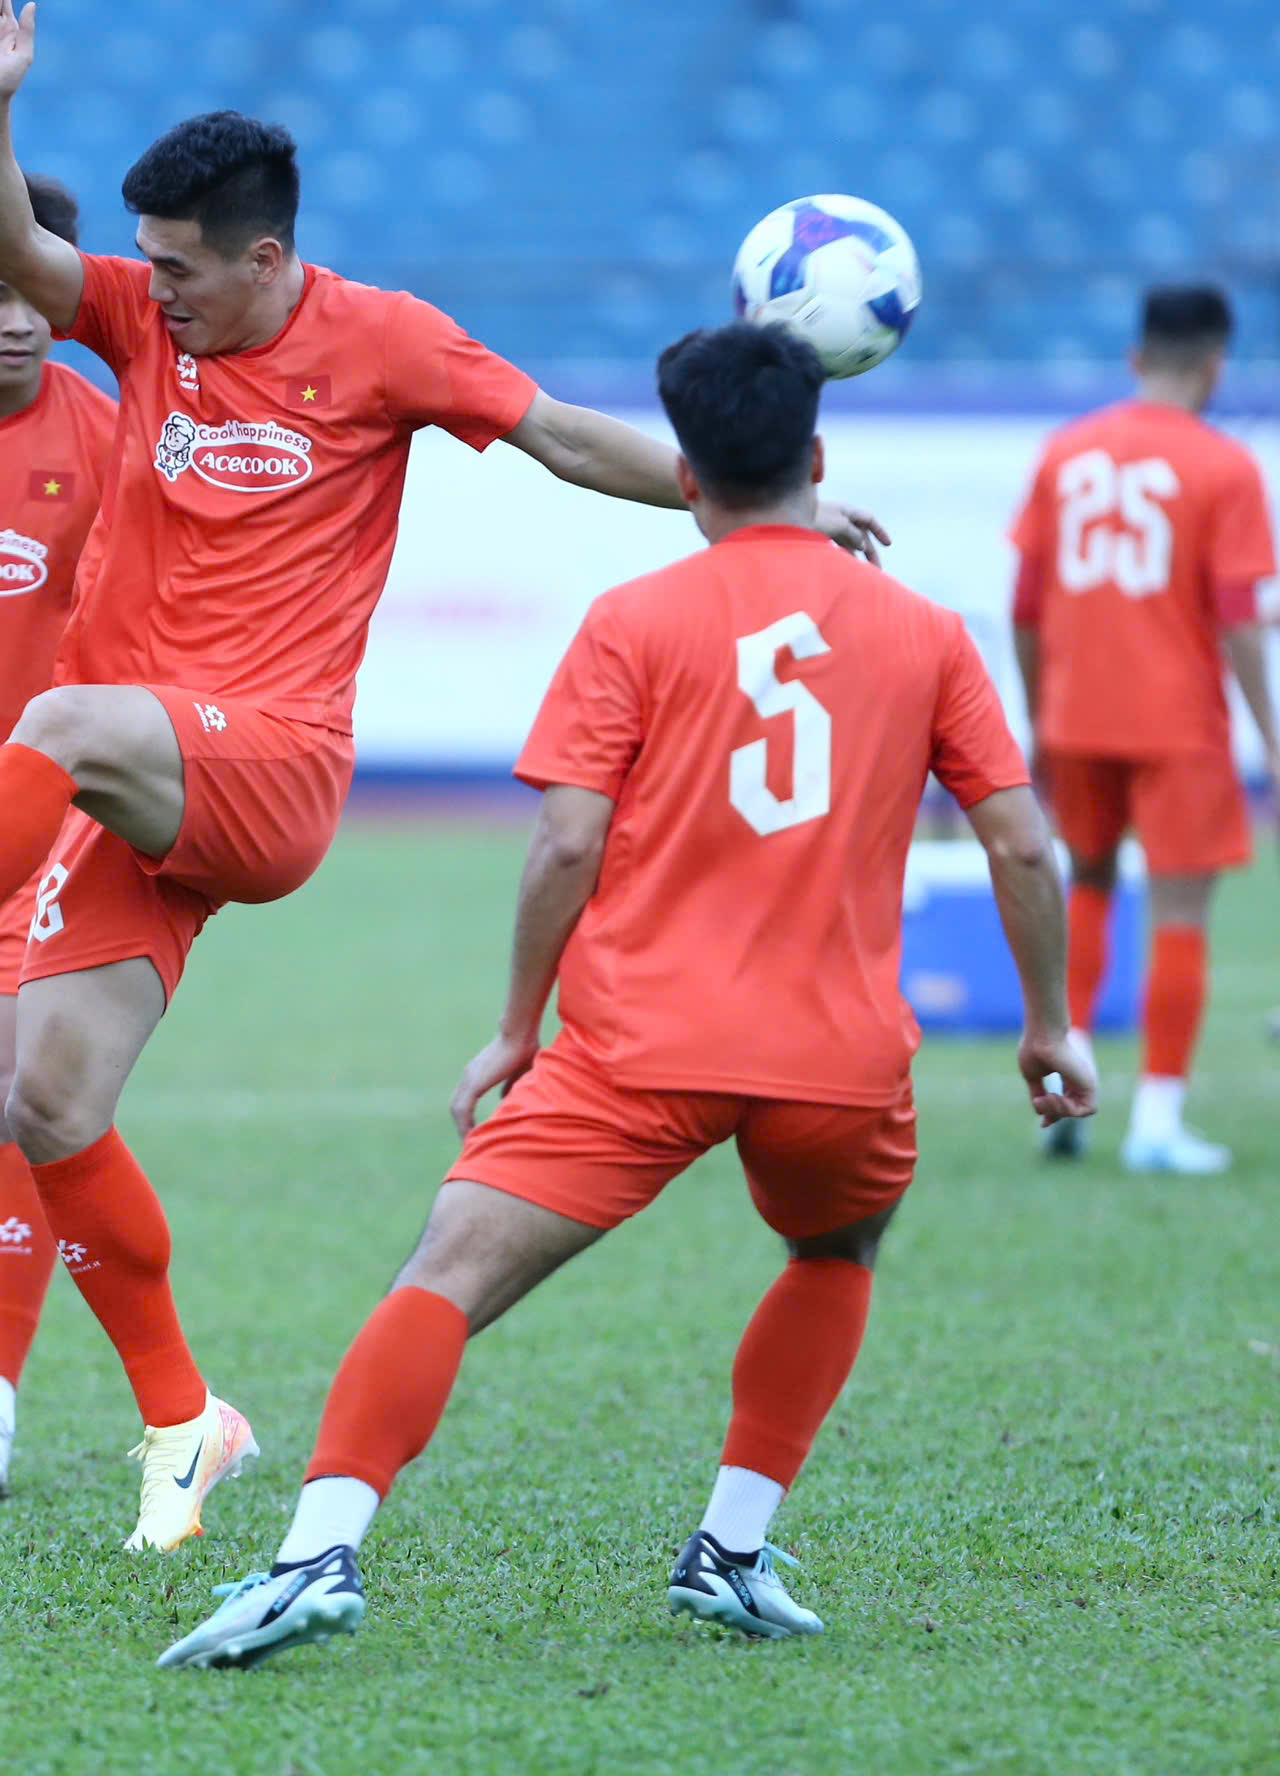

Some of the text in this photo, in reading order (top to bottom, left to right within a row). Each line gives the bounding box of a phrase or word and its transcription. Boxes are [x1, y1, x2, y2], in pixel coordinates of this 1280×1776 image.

[198, 422, 309, 451] Cook happiness
[1057, 448, 1181, 598] 25
[729, 611, 832, 836] 5
